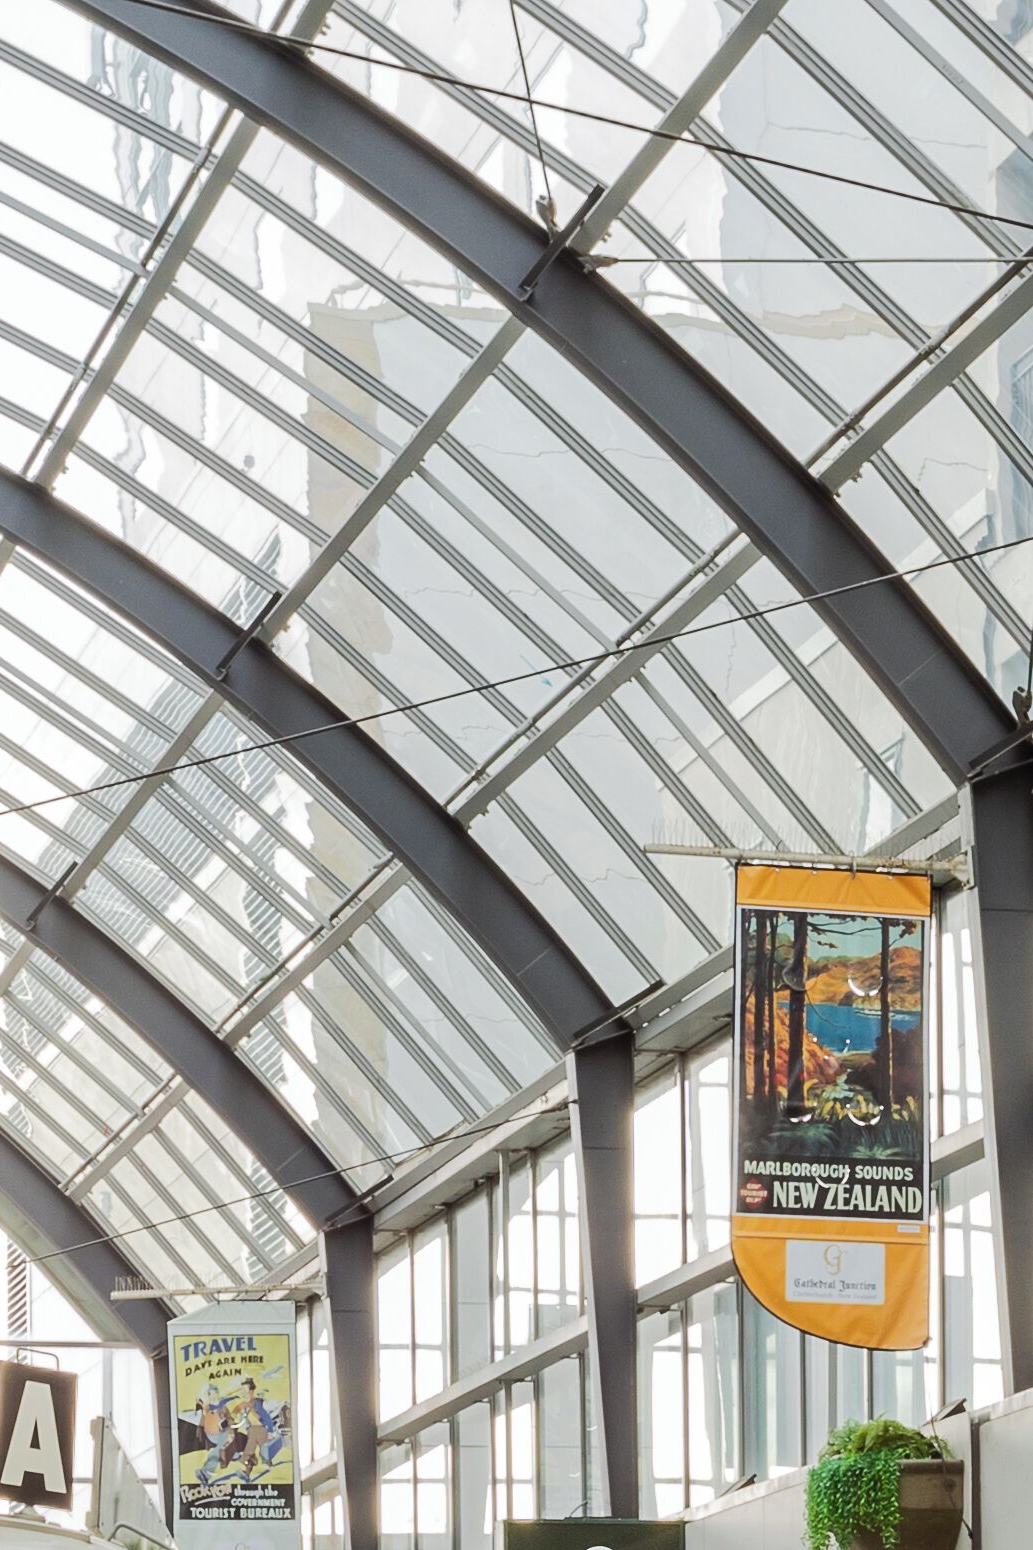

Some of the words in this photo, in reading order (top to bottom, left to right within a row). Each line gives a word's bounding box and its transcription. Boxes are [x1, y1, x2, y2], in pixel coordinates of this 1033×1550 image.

[744, 1160, 850, 1179] MARLBOROUGH
[855, 1165, 914, 1181] SOUNDS
[773, 1181, 819, 1209] NEW
[823, 1183, 922, 1214] ZEALAND
[839, 1280, 877, 1292] Junction
[180, 1337, 257, 1362] TRAVEL
[185, 1360, 212, 1377] DAYS
[216, 1356, 236, 1366] ARE
[241, 1355, 264, 1364] HERE
[209, 1368, 242, 1381] AGAIN
[0, 1380, 67, 1494] A
[234, 1485, 264, 1499] through
[265, 1485, 278, 1497] the
[231, 1498, 286, 1507] GOVERNMENT
[190, 1507, 236, 1519] TOURIST
[240, 1507, 292, 1519] BUREAUX
